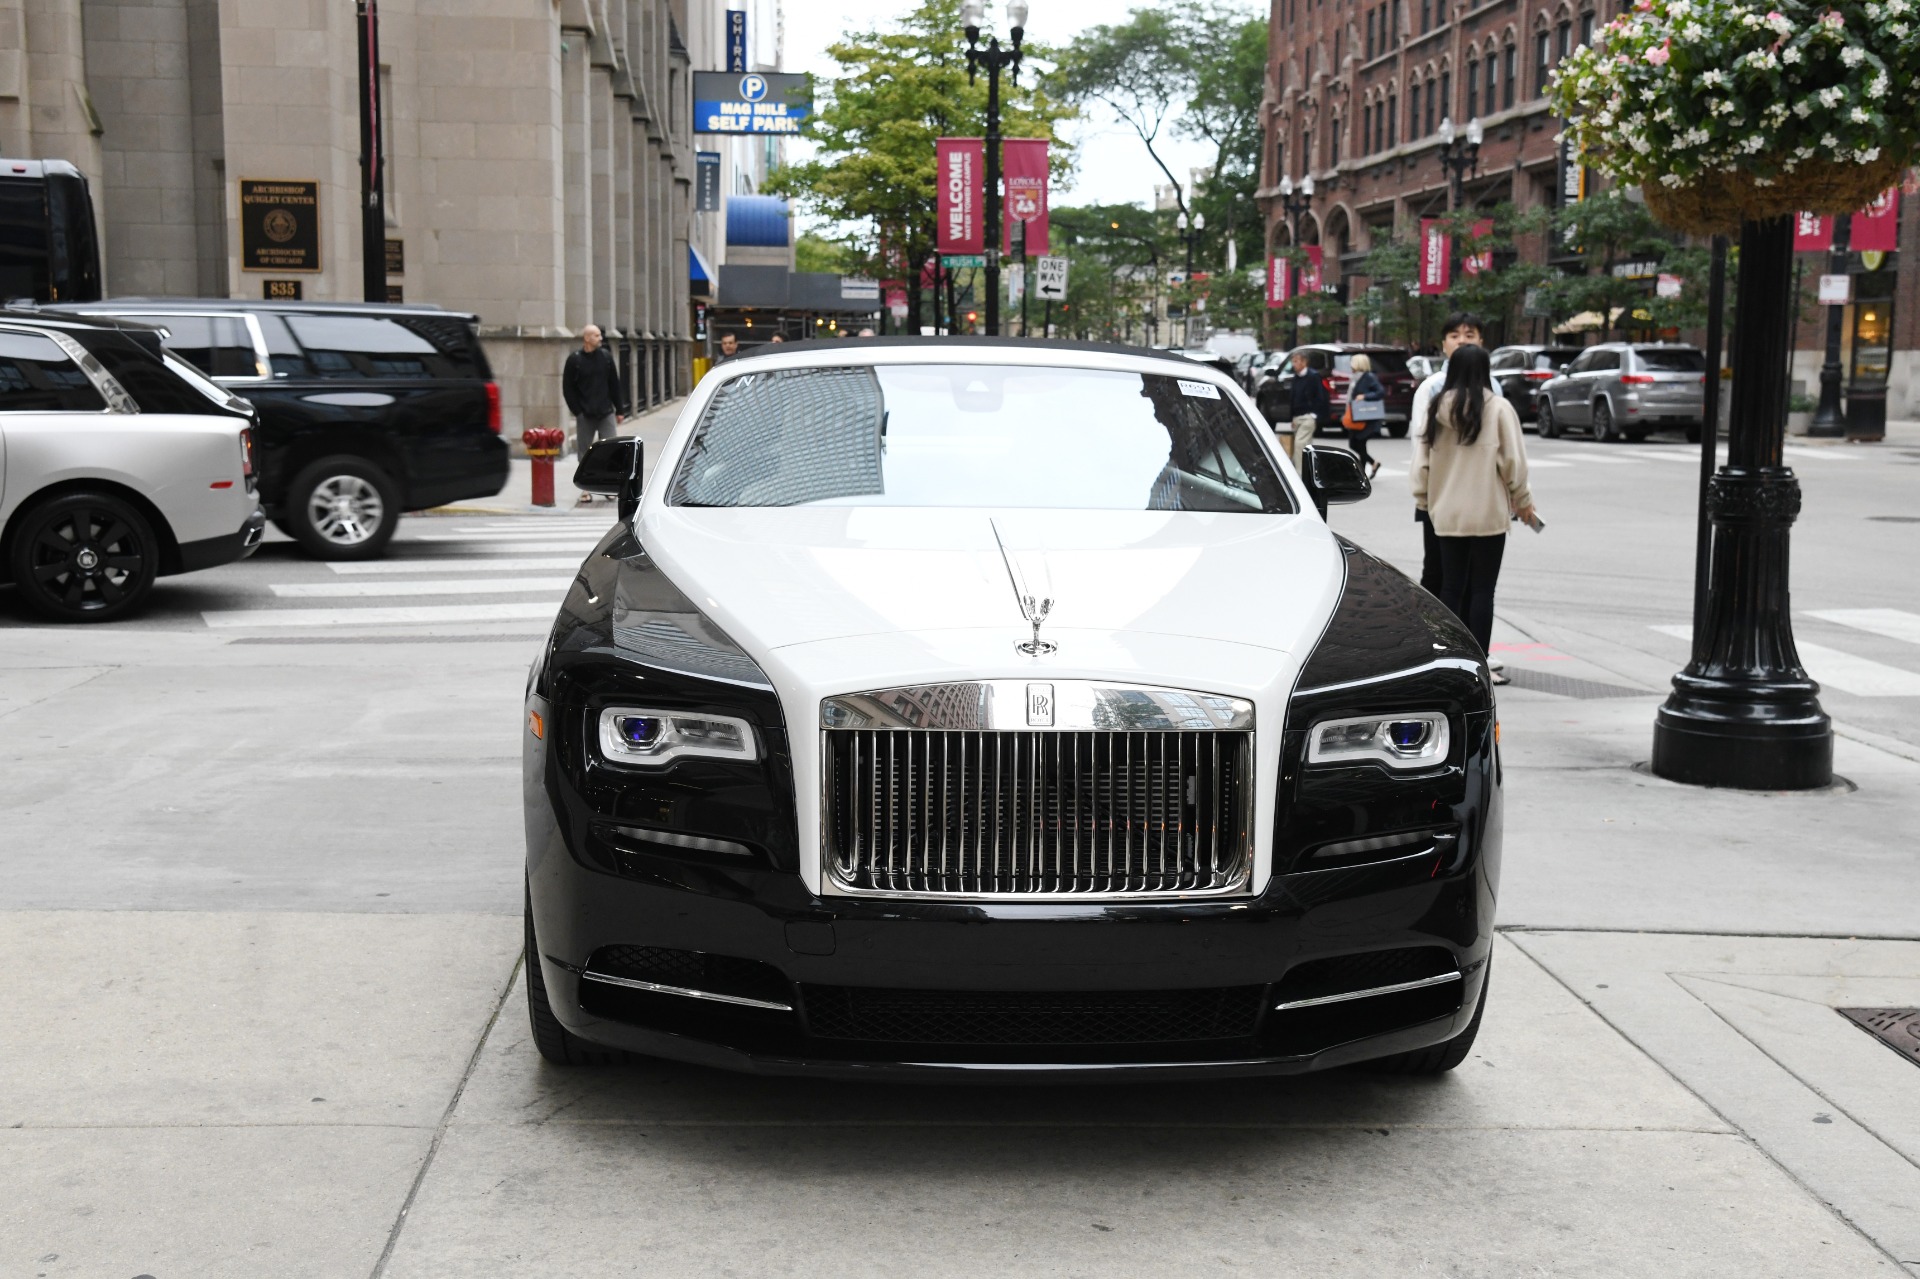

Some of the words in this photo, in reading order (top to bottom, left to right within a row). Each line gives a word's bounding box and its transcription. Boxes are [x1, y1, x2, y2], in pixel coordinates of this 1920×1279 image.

[747, 78, 762, 98] P
[720, 102, 752, 115] MAG
[754, 103, 787, 116] MILE
[708, 116, 751, 130] SELF
[753, 116, 799, 131] PARK
[252, 185, 306, 194] ARCHBISHOP
[949, 152, 963, 240] WELCOME
[243, 195, 280, 204] QUIGLEY
[281, 196, 315, 205] CENTER
[271, 257, 303, 265] CHICAGO
[1041, 260, 1064, 272] ONE
[1040, 272, 1064, 283] WAY
[270, 282, 295, 296] 835
[1033, 695, 1048, 715] RR
